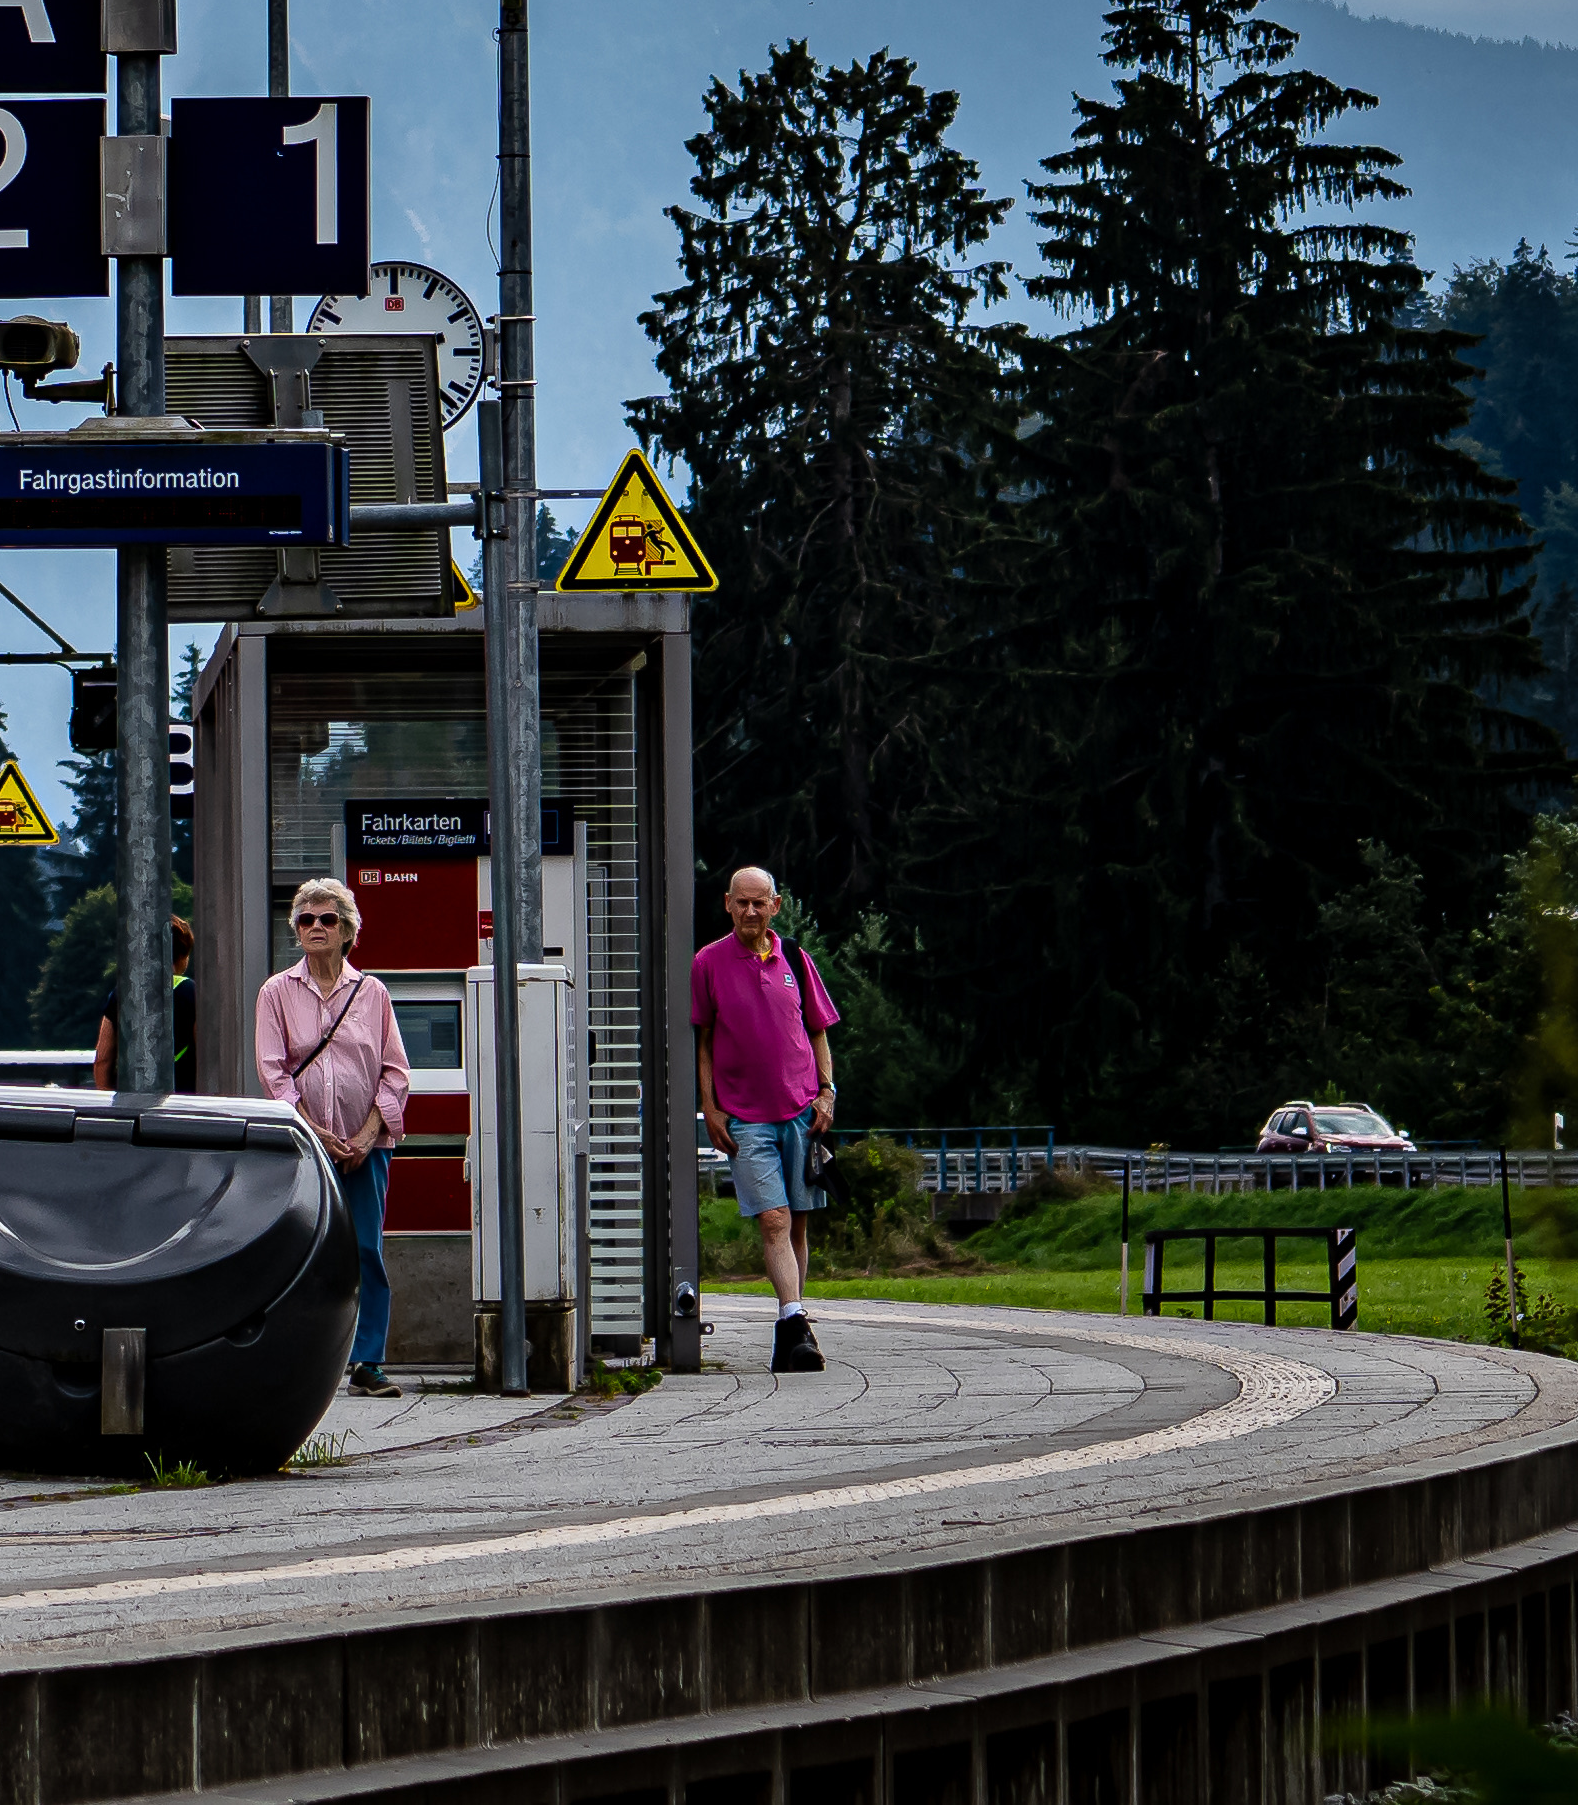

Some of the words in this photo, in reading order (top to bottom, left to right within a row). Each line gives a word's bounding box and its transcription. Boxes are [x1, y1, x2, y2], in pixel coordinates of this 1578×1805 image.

[283, 103, 338, 245] 1
[386, 299, 403, 310] DB
[19, 468, 240, 495] Fahrgastinformation
[362, 814, 461, 831] Fahrkarten
[361, 872, 379, 883] DB
[385, 873, 418, 883] BAHN
